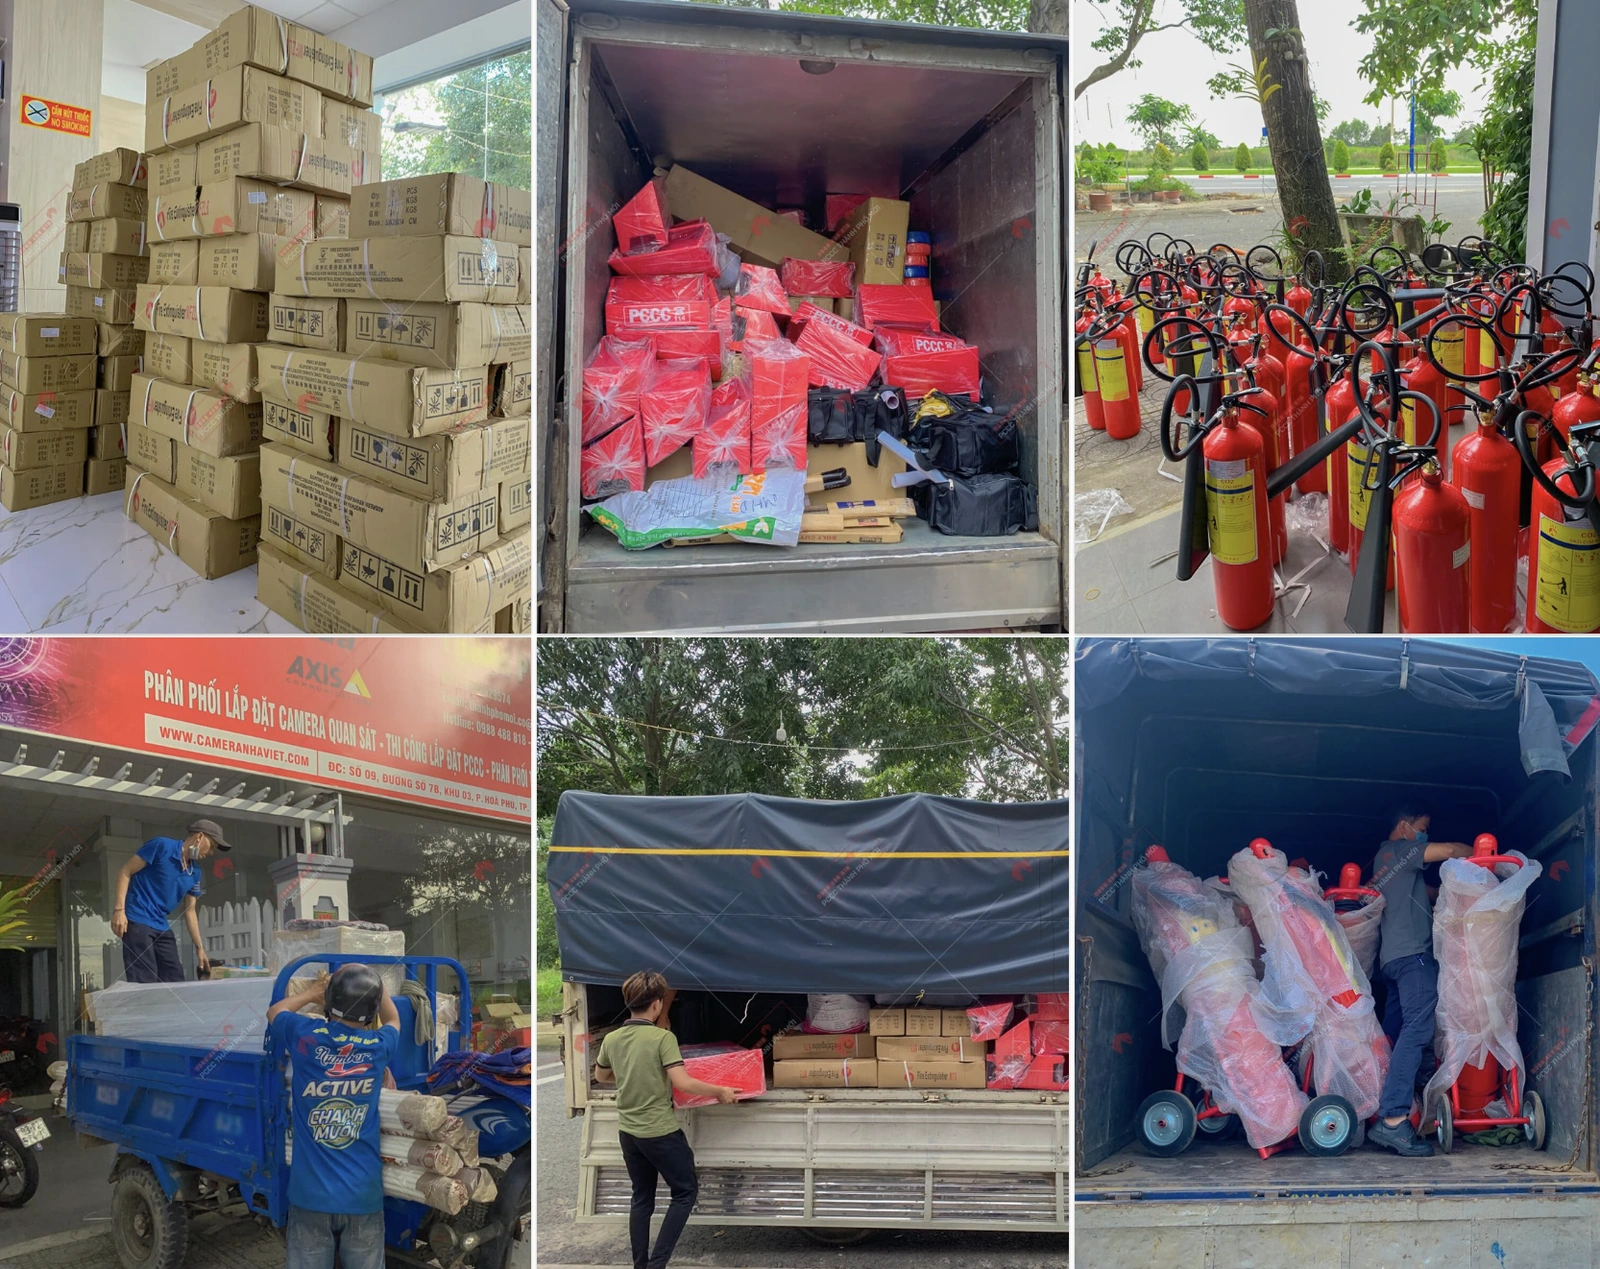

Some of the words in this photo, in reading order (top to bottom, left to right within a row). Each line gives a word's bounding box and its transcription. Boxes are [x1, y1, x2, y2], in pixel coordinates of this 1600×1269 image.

[51, 118, 60, 128] NO
[62, 120, 89, 134] SMOKING
[629, 307, 671, 323] PCCC
[812, 309, 846, 332] PCCC
[916, 339, 945, 351] PCCC
[286, 656, 342, 689] AXIS
[145, 669, 184, 707] PHÂN
[189, 678, 221, 715] PHỐI
[225, 684, 248, 720] LẮP
[252, 696, 275, 732] ĐẶT
[279, 704, 326, 740] CAMERA
[328, 717, 356, 747] QUAN
[359, 722, 376, 751] SÁT
[386, 733, 401, 758] THI
[404, 734, 427, 764] CÔNG
[429, 738, 445, 767] LẮP
[447, 747, 461, 776] ĐẶT
[463, 753, 484, 776] PCCC
[491, 759, 511, 784] PHÂN
[512, 762, 528, 788] PHỐI
[444, 710, 474, 730] Hotline:
[476, 720, 495, 737] 0988
[498, 726, 511, 741] 488
[513, 731, 526, 745] 818
[159, 726, 309, 766] WWW.CAMERANHAVIET.COM
[328, 762, 346, 774] ĐC:
[349, 765, 362, 777] SỐ
[365, 769, 379, 782] 09,
[415, 780, 426, 791] SỐ
[429, 783, 442, 795] 7B,
[444, 788, 460, 798] KHU
[462, 790, 474, 802] 03,
[476, 793, 483, 802] P.
[315, 1046, 372, 1065] Number
[302, 1078, 374, 1097] ACTIVE
[309, 1104, 369, 1126] CHANH
